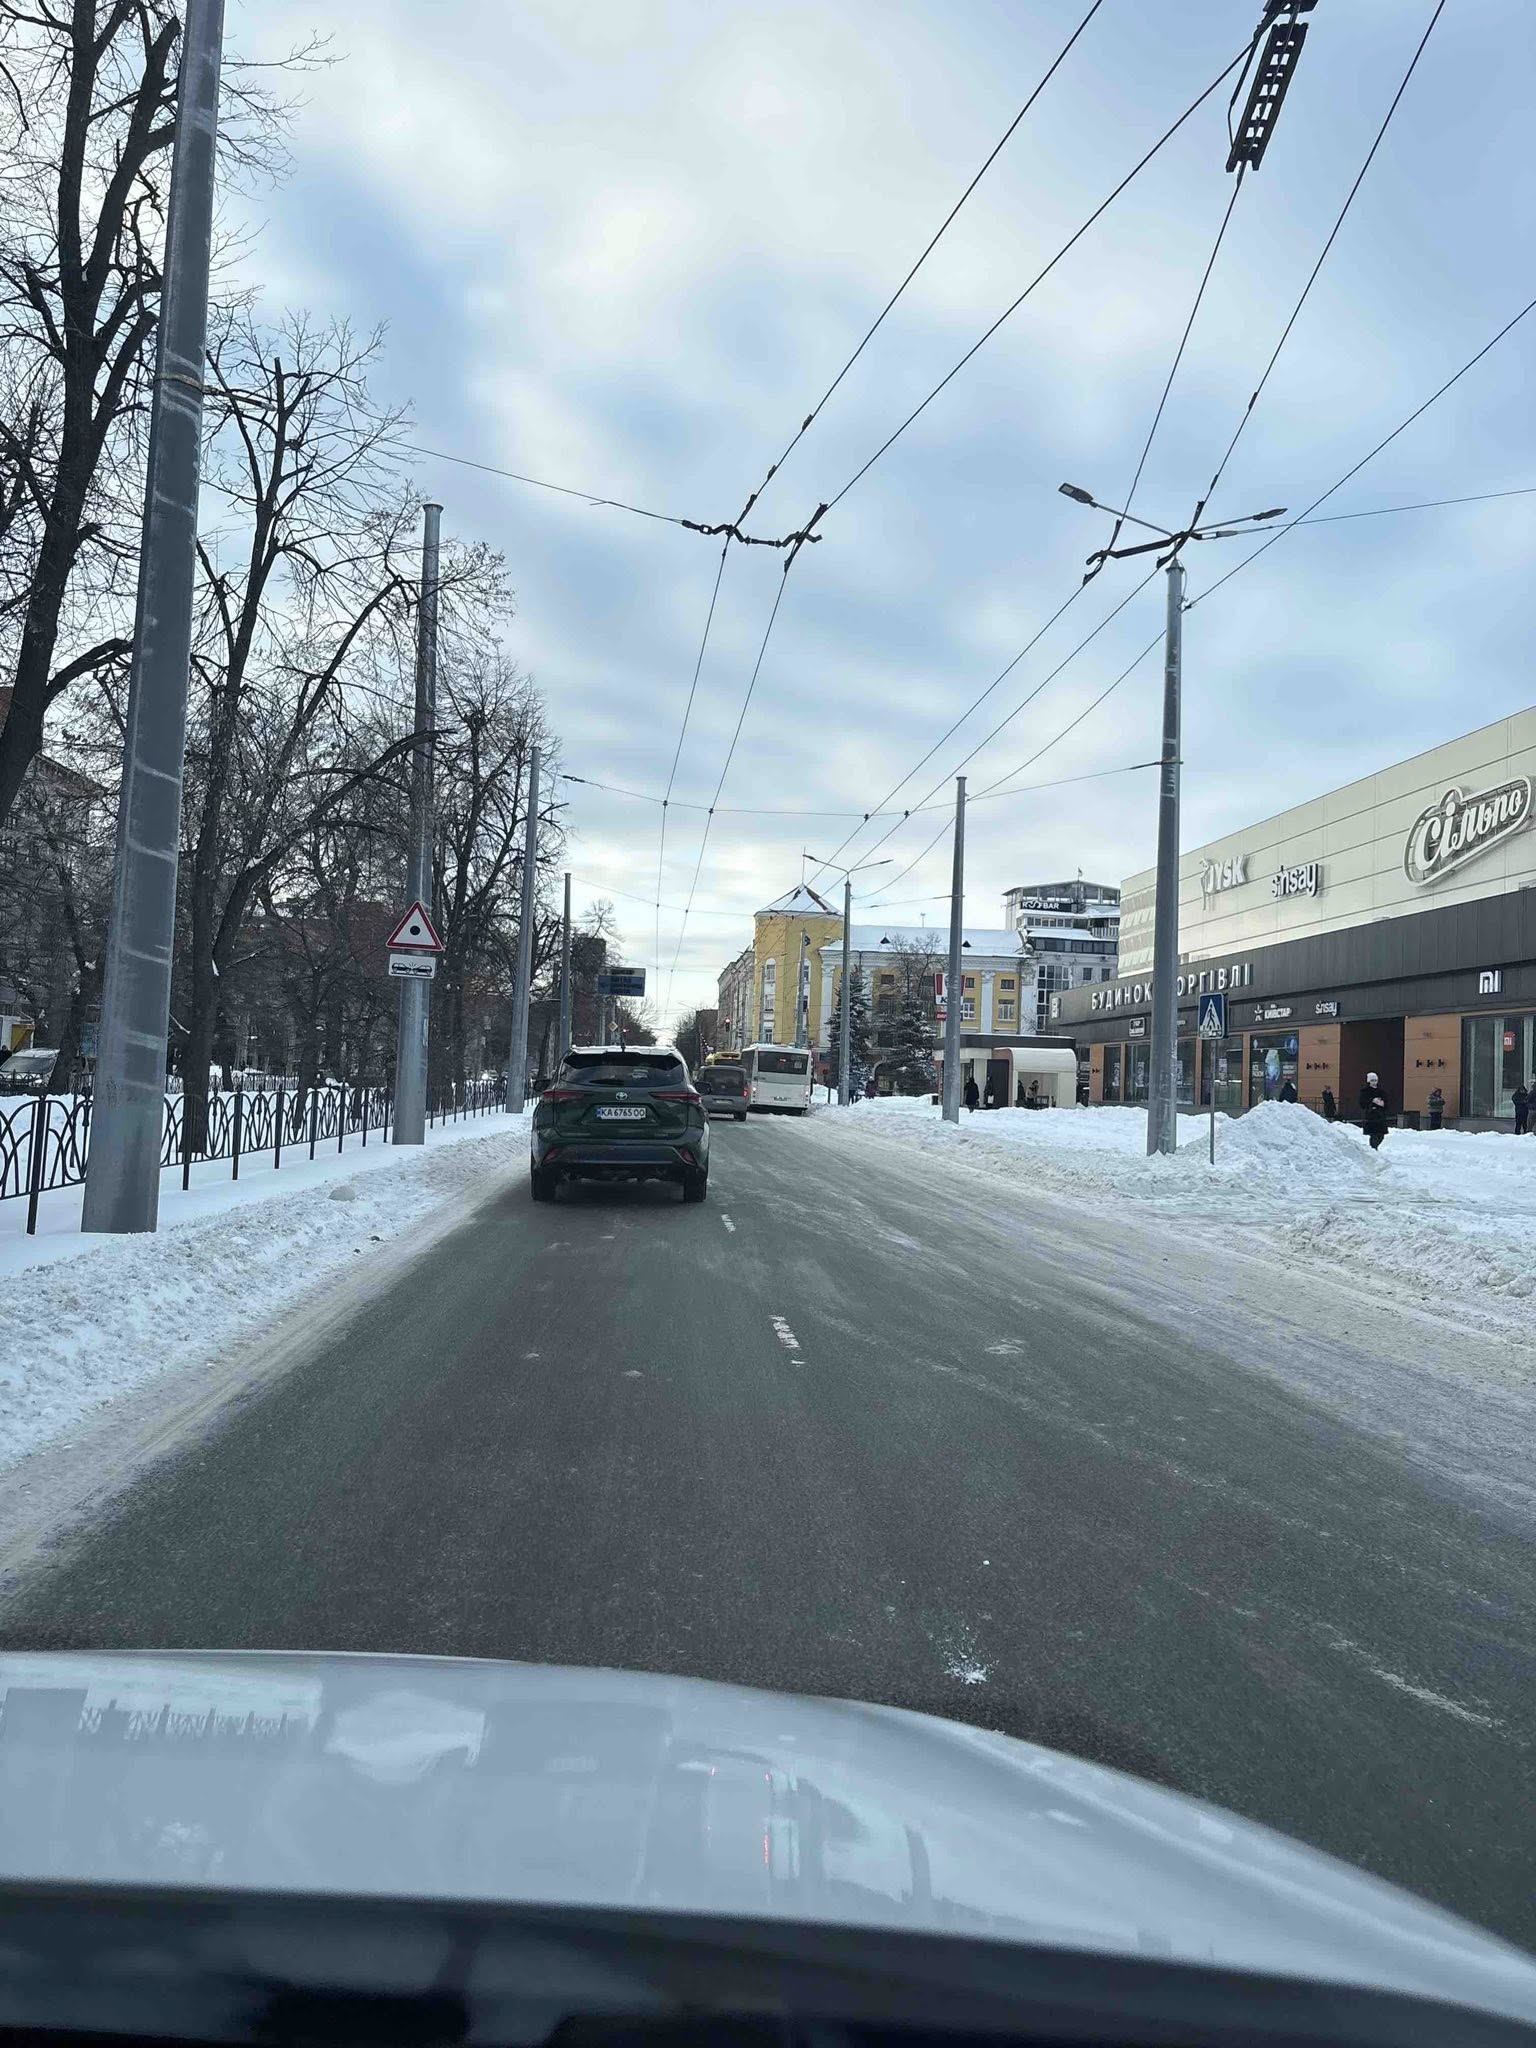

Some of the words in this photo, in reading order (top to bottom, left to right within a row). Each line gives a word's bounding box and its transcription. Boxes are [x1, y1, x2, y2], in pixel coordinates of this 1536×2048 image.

[1206, 855, 1246, 893] JYSK
[1271, 864, 1318, 898] sinsay
[1091, 982, 1153, 1011] БУДИНОК
[1177, 963, 1251, 997] ОРГІВЛІ
